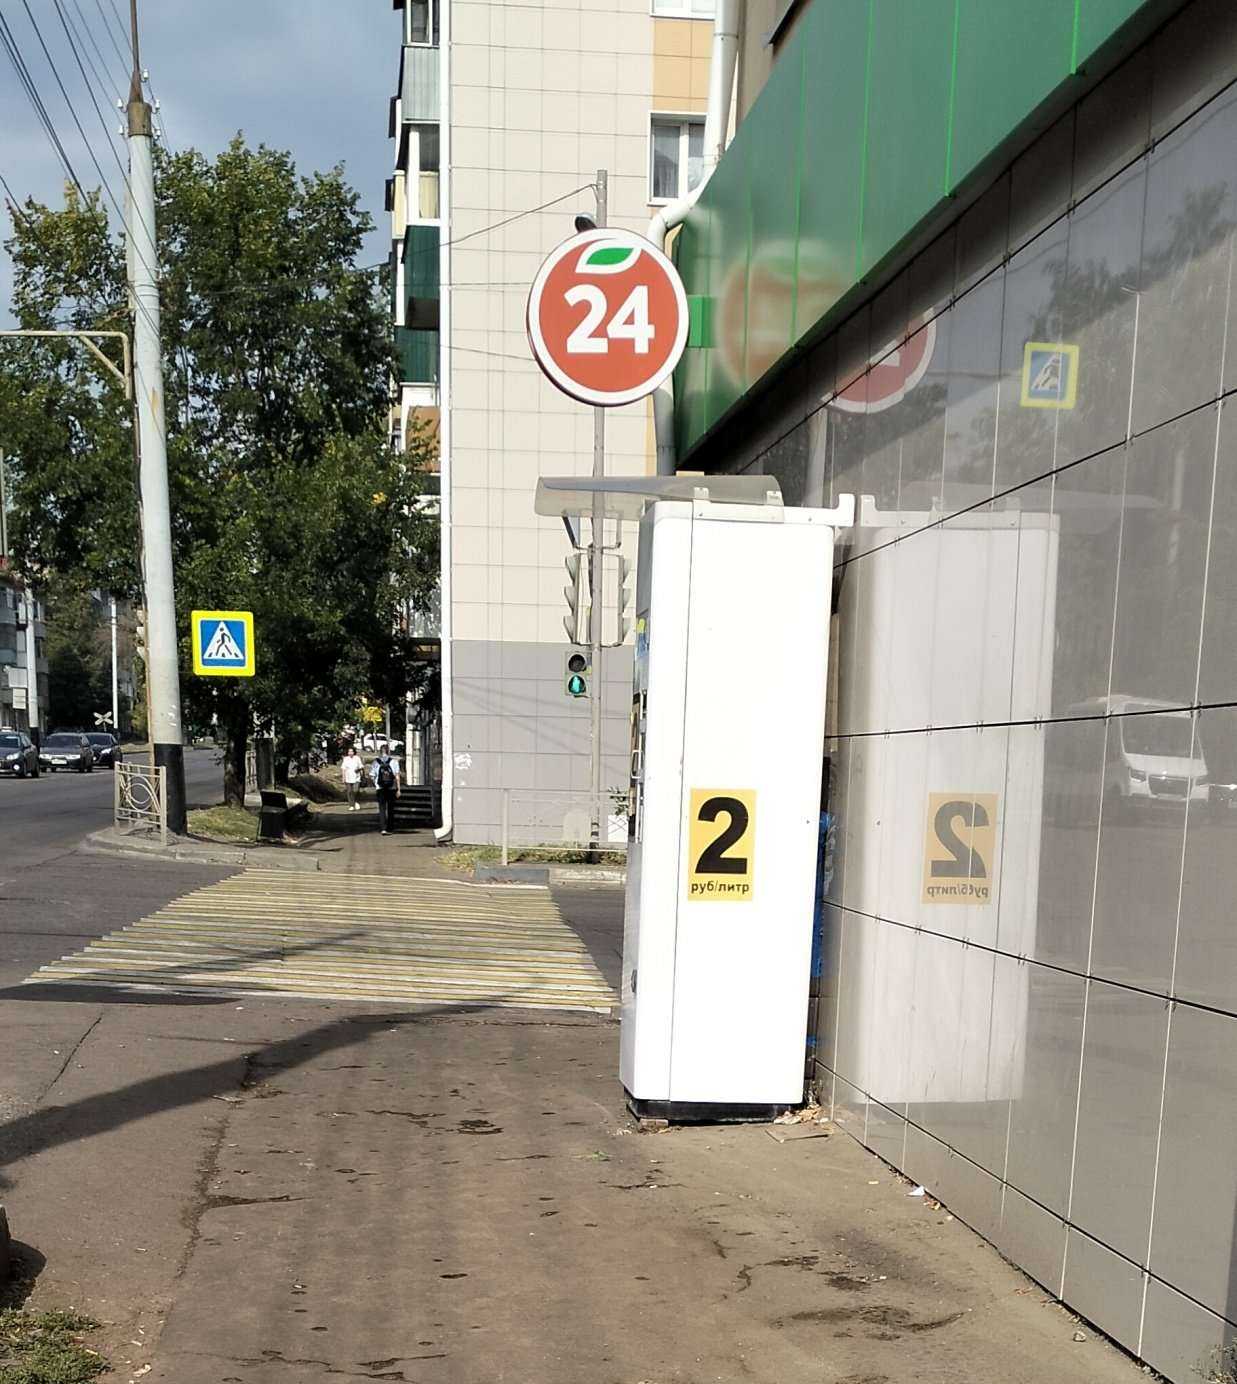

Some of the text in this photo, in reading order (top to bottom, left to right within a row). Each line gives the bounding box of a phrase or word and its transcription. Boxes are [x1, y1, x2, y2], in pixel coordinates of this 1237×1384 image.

[564, 284, 655, 354] 24
[695, 796, 748, 874] 2
[691, 880, 749, 895] руб/литр
